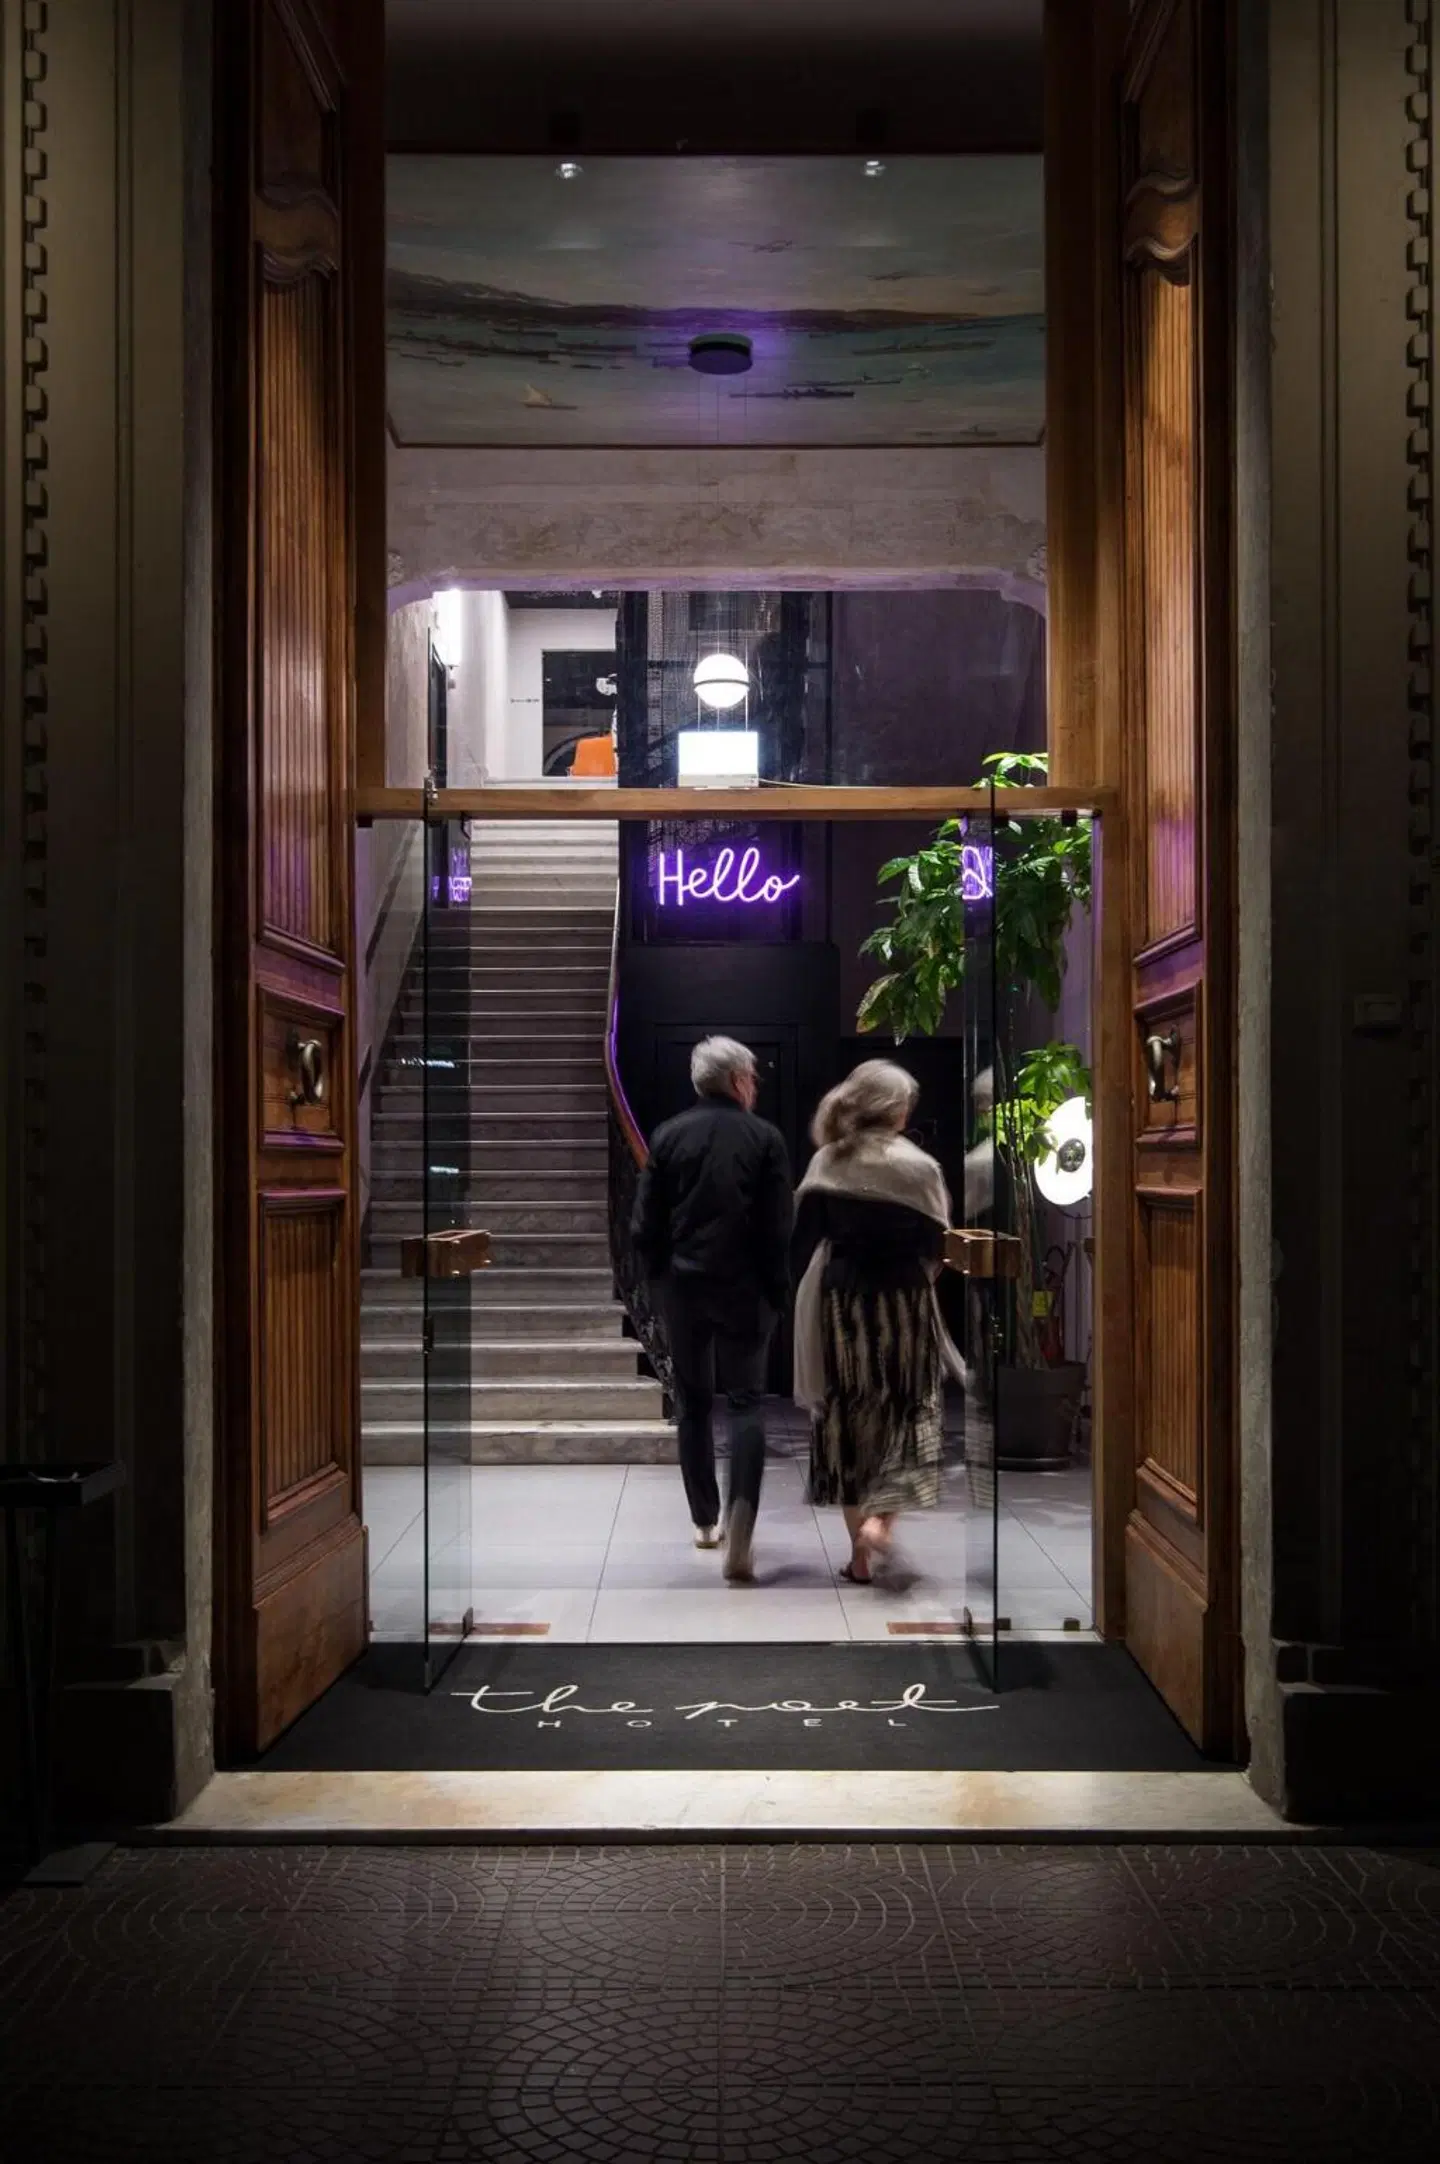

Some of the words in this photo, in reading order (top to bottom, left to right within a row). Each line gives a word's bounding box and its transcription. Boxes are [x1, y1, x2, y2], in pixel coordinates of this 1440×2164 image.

[658, 846, 801, 907] Hello
[450, 1683, 655, 1714] the
[674, 1682, 1000, 1720] poet
[536, 1718, 908, 1729] HOTEL
